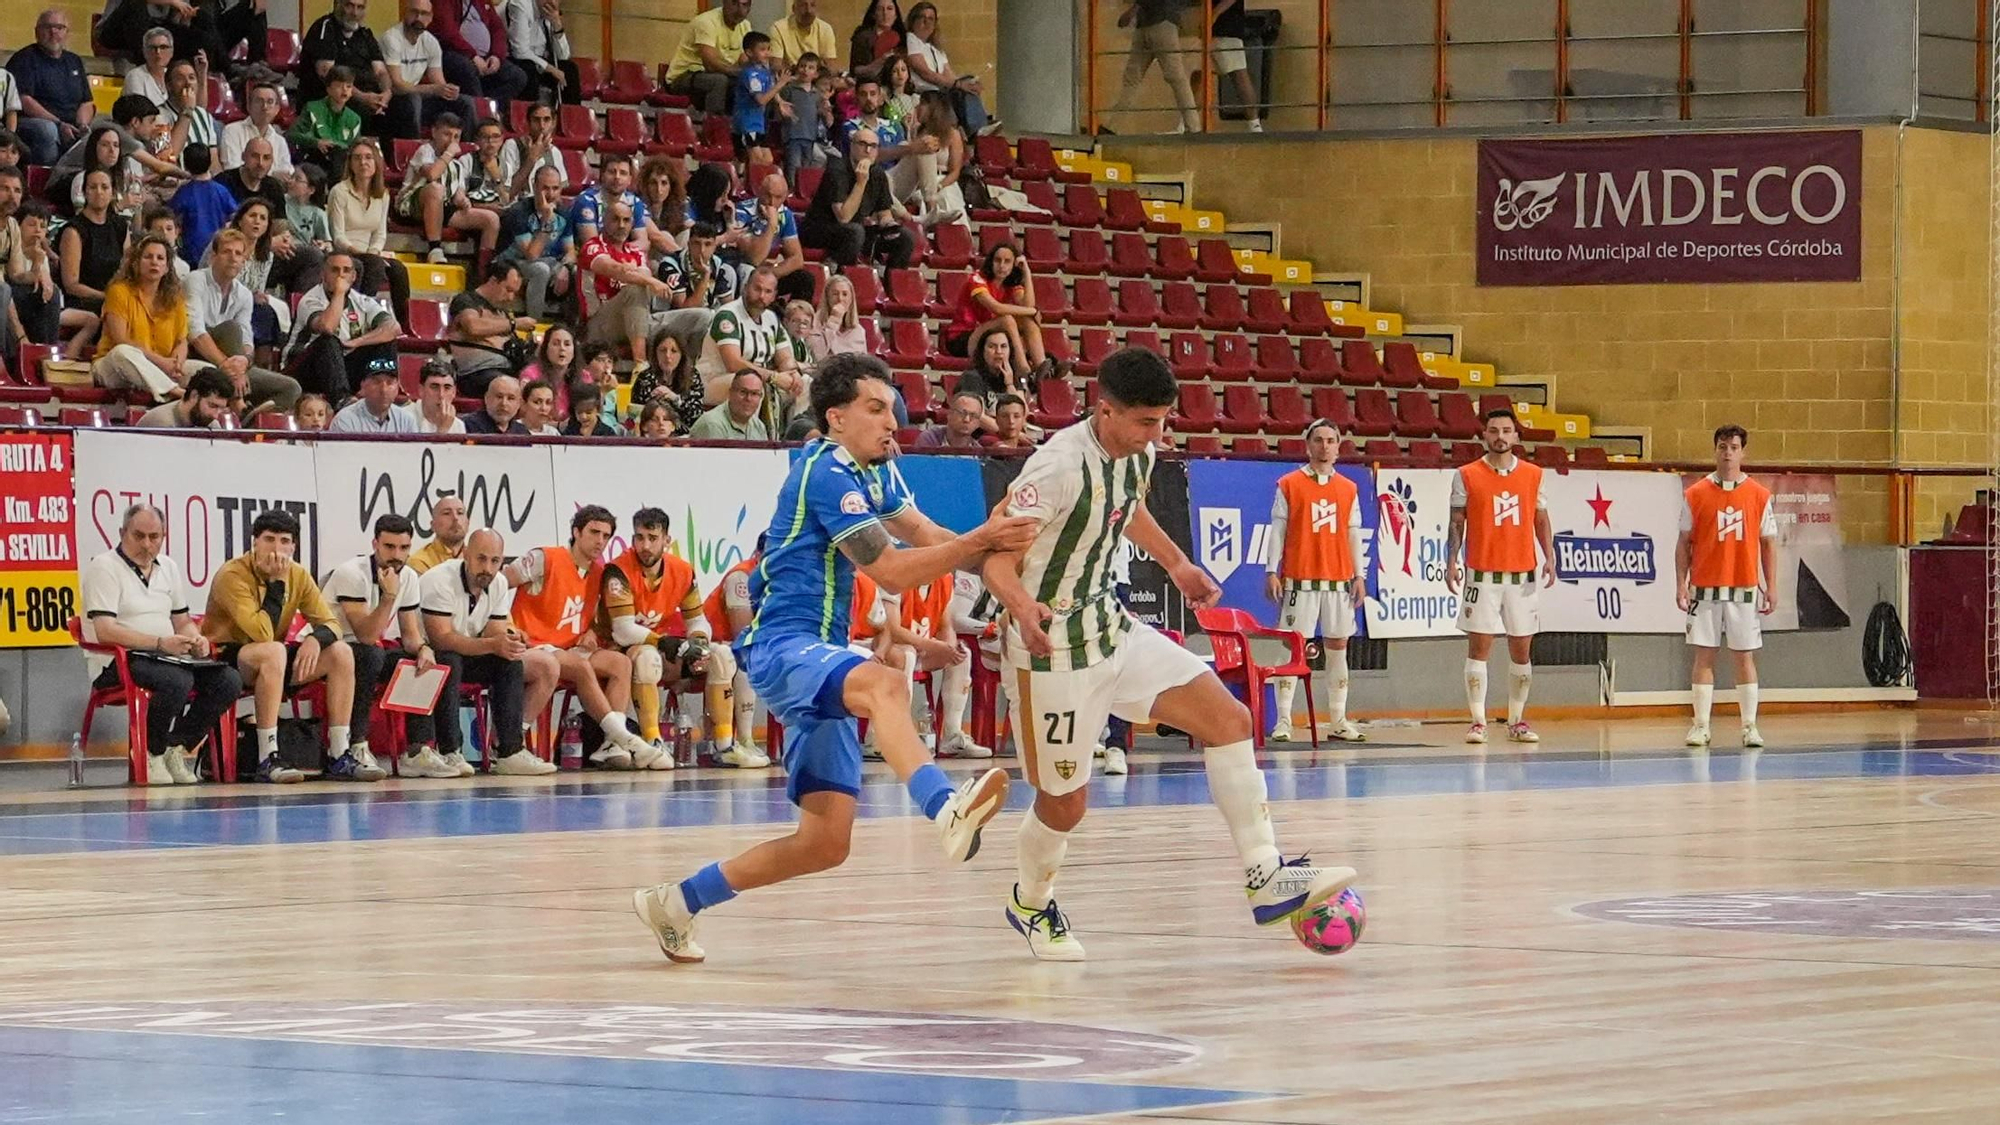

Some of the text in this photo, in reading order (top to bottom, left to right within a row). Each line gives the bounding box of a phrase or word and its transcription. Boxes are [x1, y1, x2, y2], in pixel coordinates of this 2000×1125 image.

[1573, 165, 1846, 229] IMDECO
[1494, 238, 1843, 264] Instituto Municipal de Deportes Córdoba
[1, 443, 64, 473] RUTA 4
[4, 496, 68, 523] Km. 483
[8, 533, 70, 561] SEVILLA
[1558, 541, 1651, 573] Heineken
[0, 586, 75, 633] 1-868
[1128, 590, 1157, 603] órdoba
[1289, 590, 1298, 607] 8
[1377, 588, 1457, 629] Siempre
[1465, 586, 1479, 604] 20
[1043, 710, 1076, 745] 27
